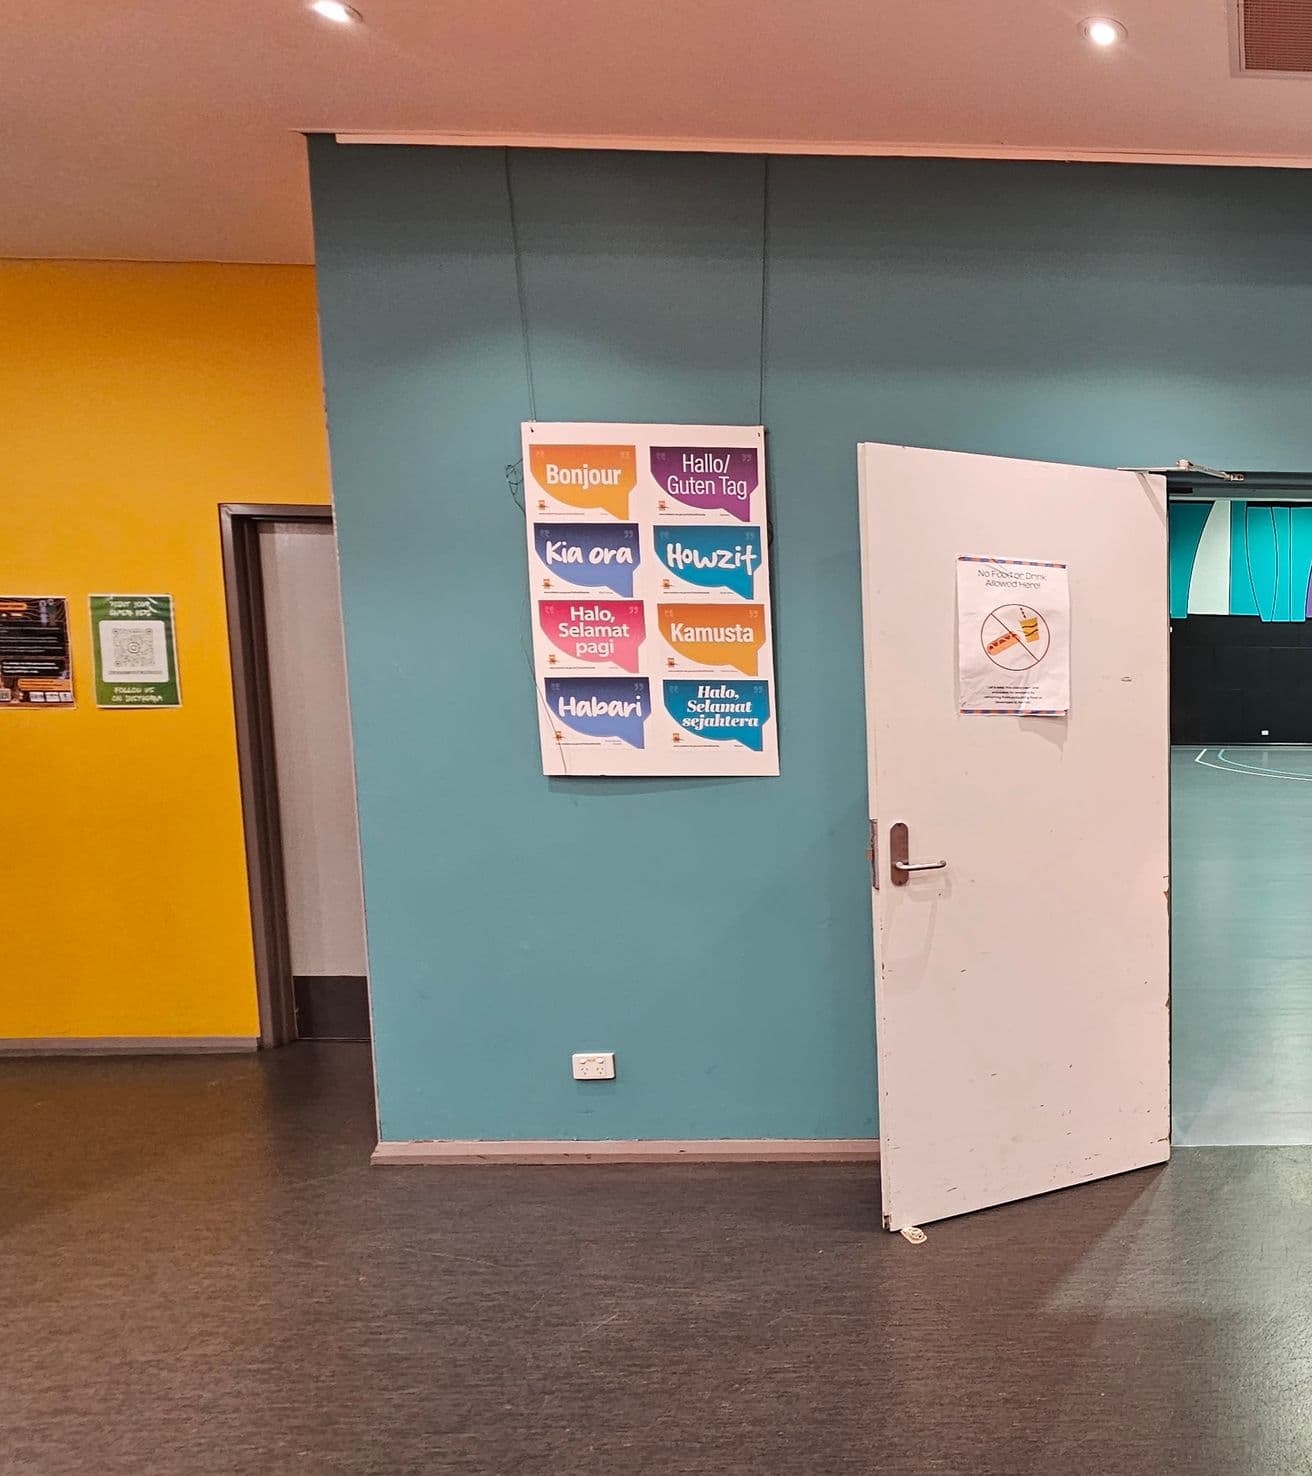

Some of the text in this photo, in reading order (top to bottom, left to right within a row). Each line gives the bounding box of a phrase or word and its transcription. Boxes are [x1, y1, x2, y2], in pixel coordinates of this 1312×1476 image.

[682, 453, 731, 474] Hallo/
[546, 463, 622, 490] Bonjour
[667, 475, 748, 500] Guten Tag
[546, 540, 633, 566] Kia ora
[666, 542, 757, 576] Howzit
[571, 606, 616, 623] Halo,
[558, 621, 630, 639] Selamat
[670, 622, 755, 643] Kamusta
[576, 640, 615, 657] pagi
[697, 684, 740, 701] Halo,
[558, 696, 643, 718] Habari
[687, 700, 752, 713] Selamat
[682, 714, 759, 731] sejahtera
